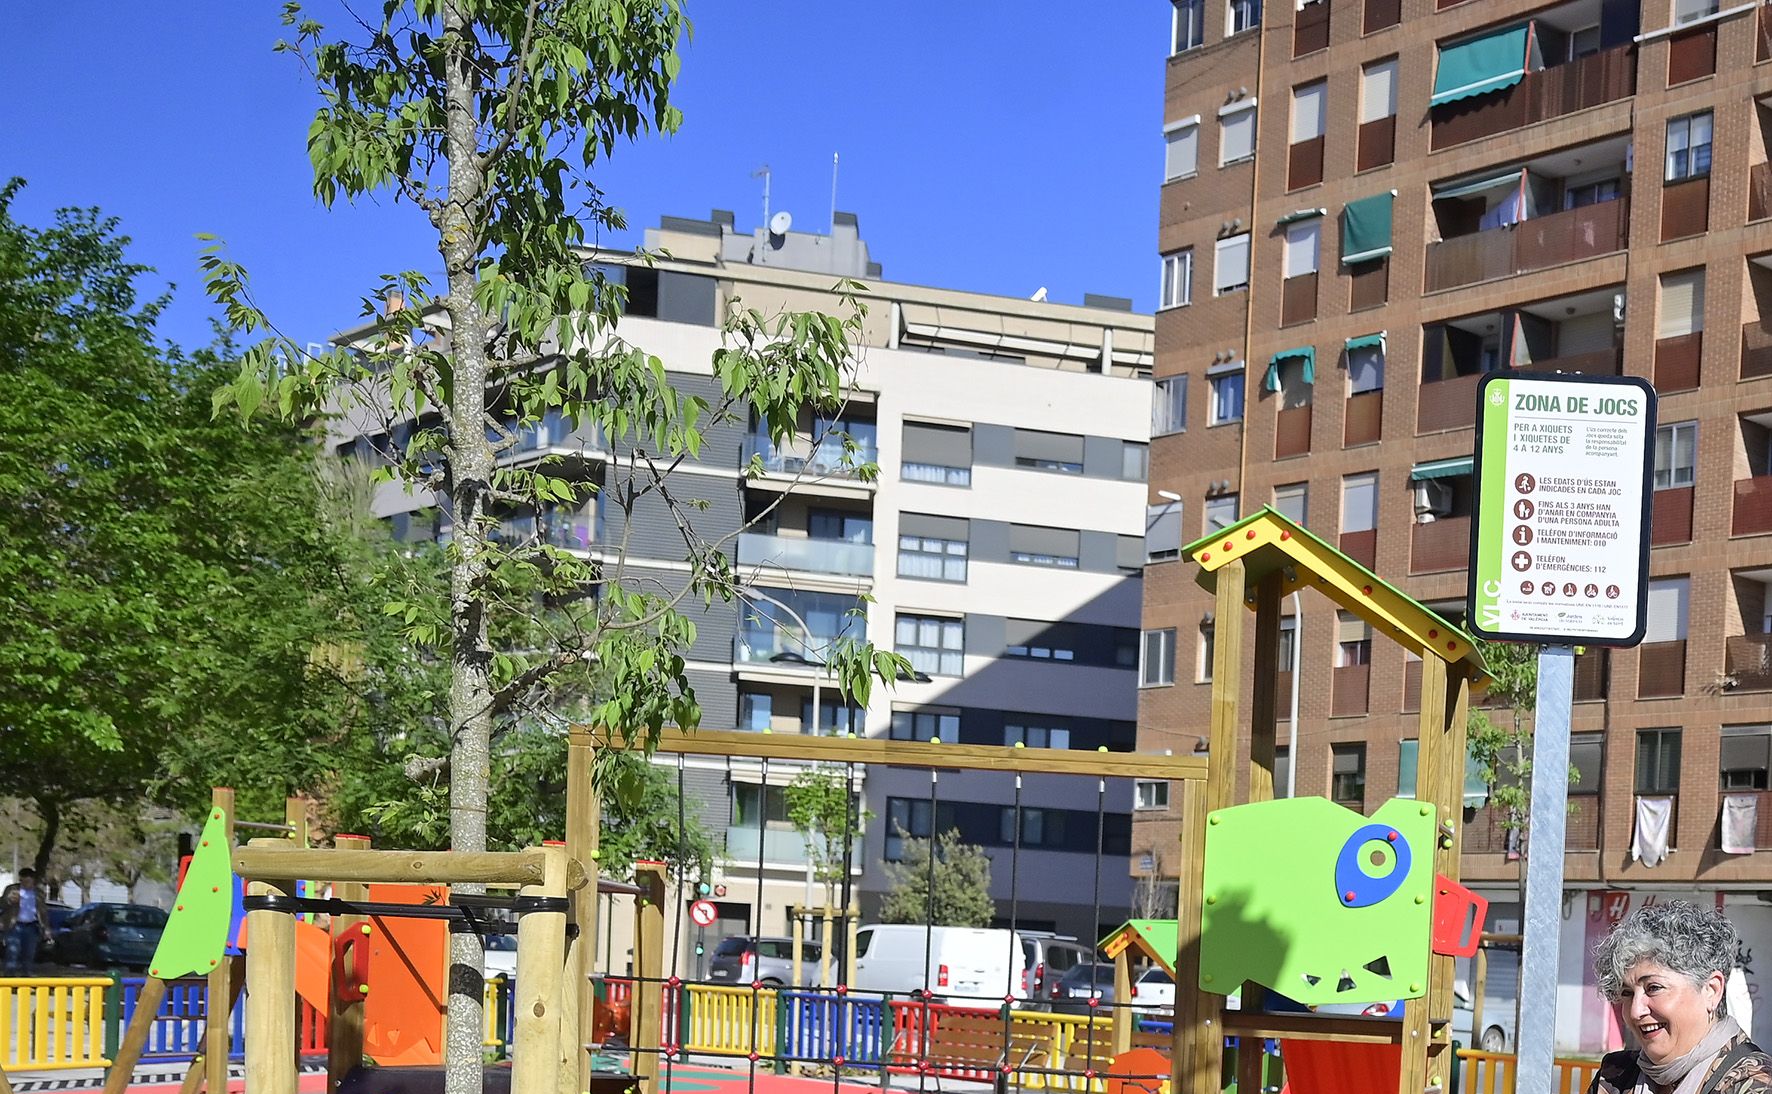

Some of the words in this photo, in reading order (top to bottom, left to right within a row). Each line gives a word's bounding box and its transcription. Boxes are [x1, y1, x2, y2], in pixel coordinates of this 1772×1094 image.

[1515, 394, 1561, 412] ZONA
[1567, 396, 1588, 413] DE
[1593, 398, 1638, 416] JOCS
[1514, 423, 1530, 432] PER
[1531, 424, 1537, 432] A
[1539, 424, 1573, 434] XIQUETS
[1520, 433, 1558, 444] XIQUETES
[1560, 435, 1571, 444] DE
[1521, 444, 1527, 452] A
[1531, 445, 1540, 453] 12
[1542, 445, 1564, 454] ANYS
[1553, 477, 1575, 486] EDATS
[1539, 484, 1575, 493] INDICADES
[1577, 486, 1586, 494] EN
[1587, 487, 1606, 495] CADA
[1608, 488, 1621, 496] JOC
[1538, 500, 1554, 508] FINS
[1555, 501, 1568, 509] ALS
[1576, 502, 1594, 510] ANYS
[1596, 503, 1611, 511] HAN
[1538, 508, 1564, 517] D'ANAR
[1565, 509, 1575, 517] EN
[1576, 510, 1617, 519] COMPANYIA
[1538, 516, 1559, 524] D'UNA
[1560, 517, 1592, 526] PERSONA
[1594, 519, 1620, 527] ADULTA
[1568, 530, 1618, 540] D'INFORMACIÓ
[1540, 537, 1592, 546] MANTENIMENT:
[1593, 539, 1606, 547] 010
[1482, 579, 1501, 627] VLC
